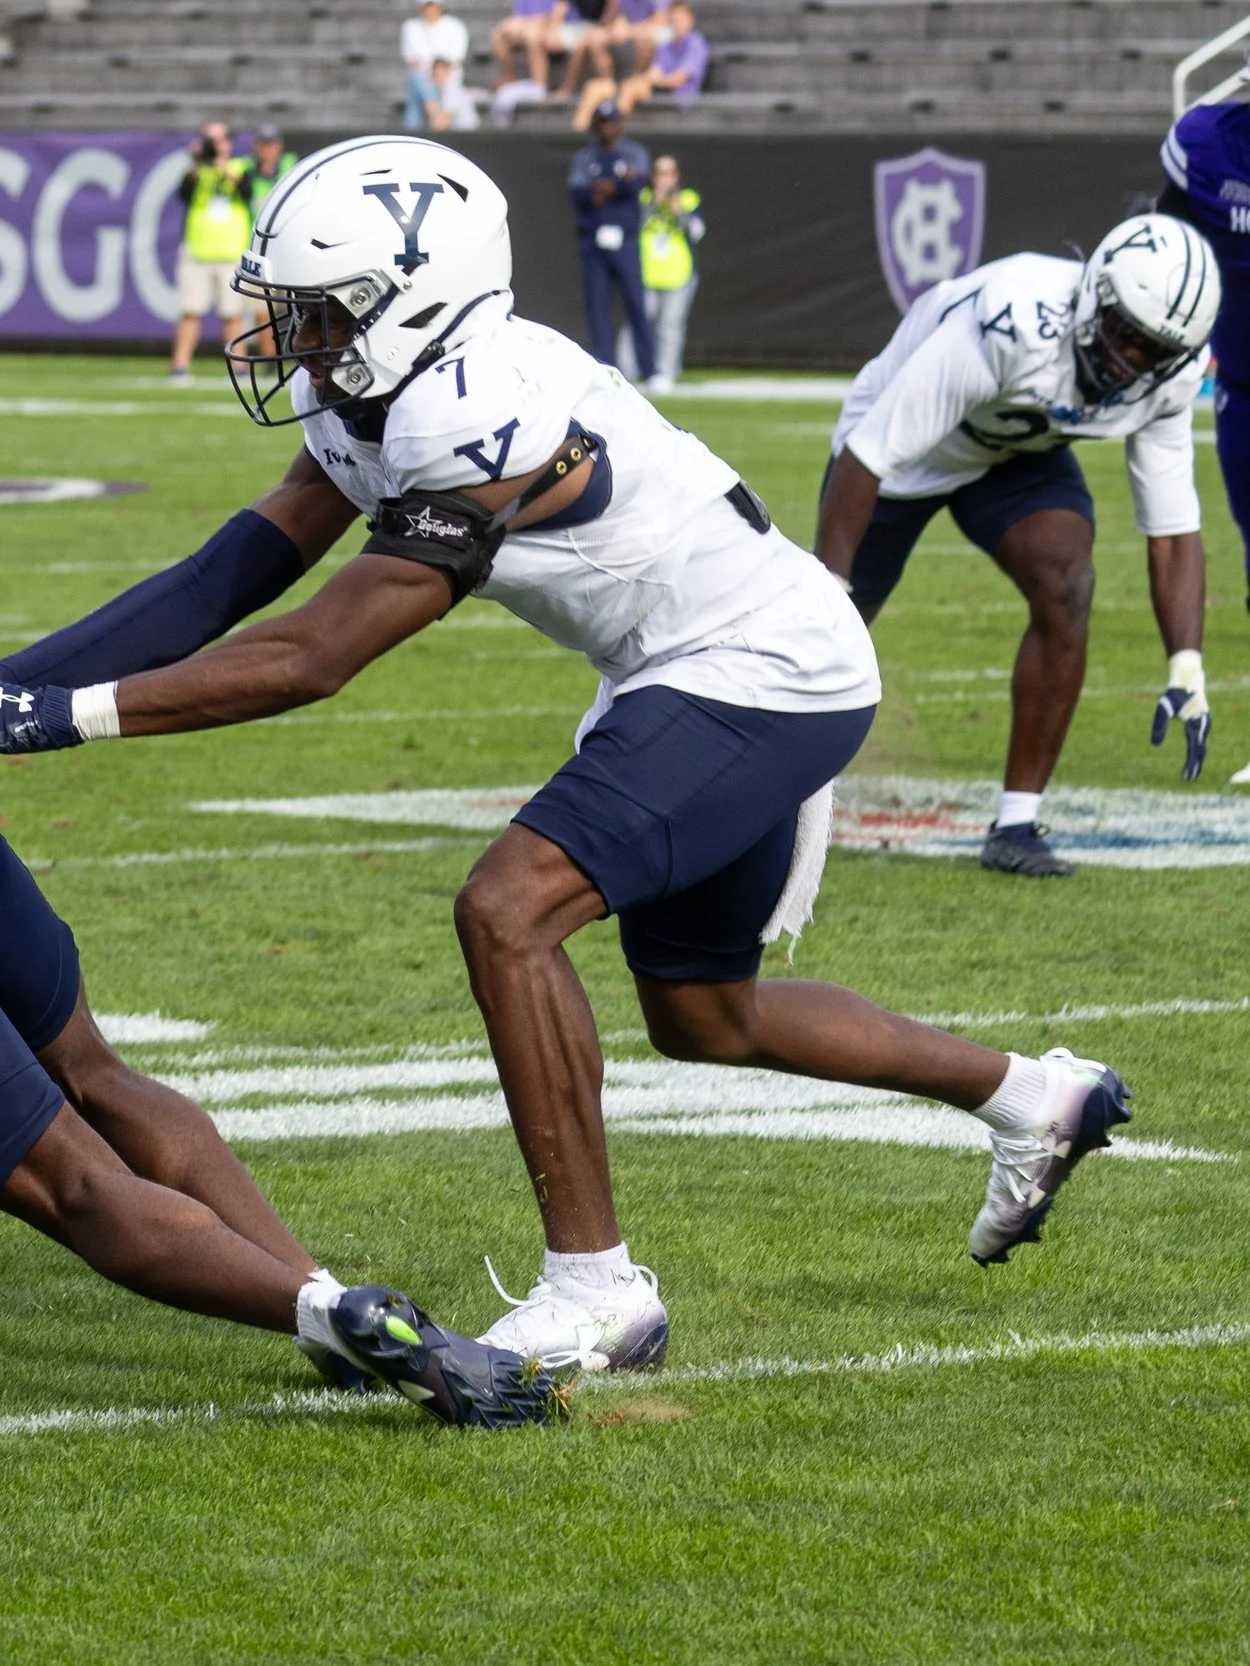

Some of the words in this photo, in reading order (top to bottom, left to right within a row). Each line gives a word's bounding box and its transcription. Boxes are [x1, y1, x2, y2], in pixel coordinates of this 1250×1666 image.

[362, 182, 445, 277] Y
[1104, 223, 1157, 265] Y
[979, 302, 1018, 343] Y
[435, 356, 467, 400] 7
